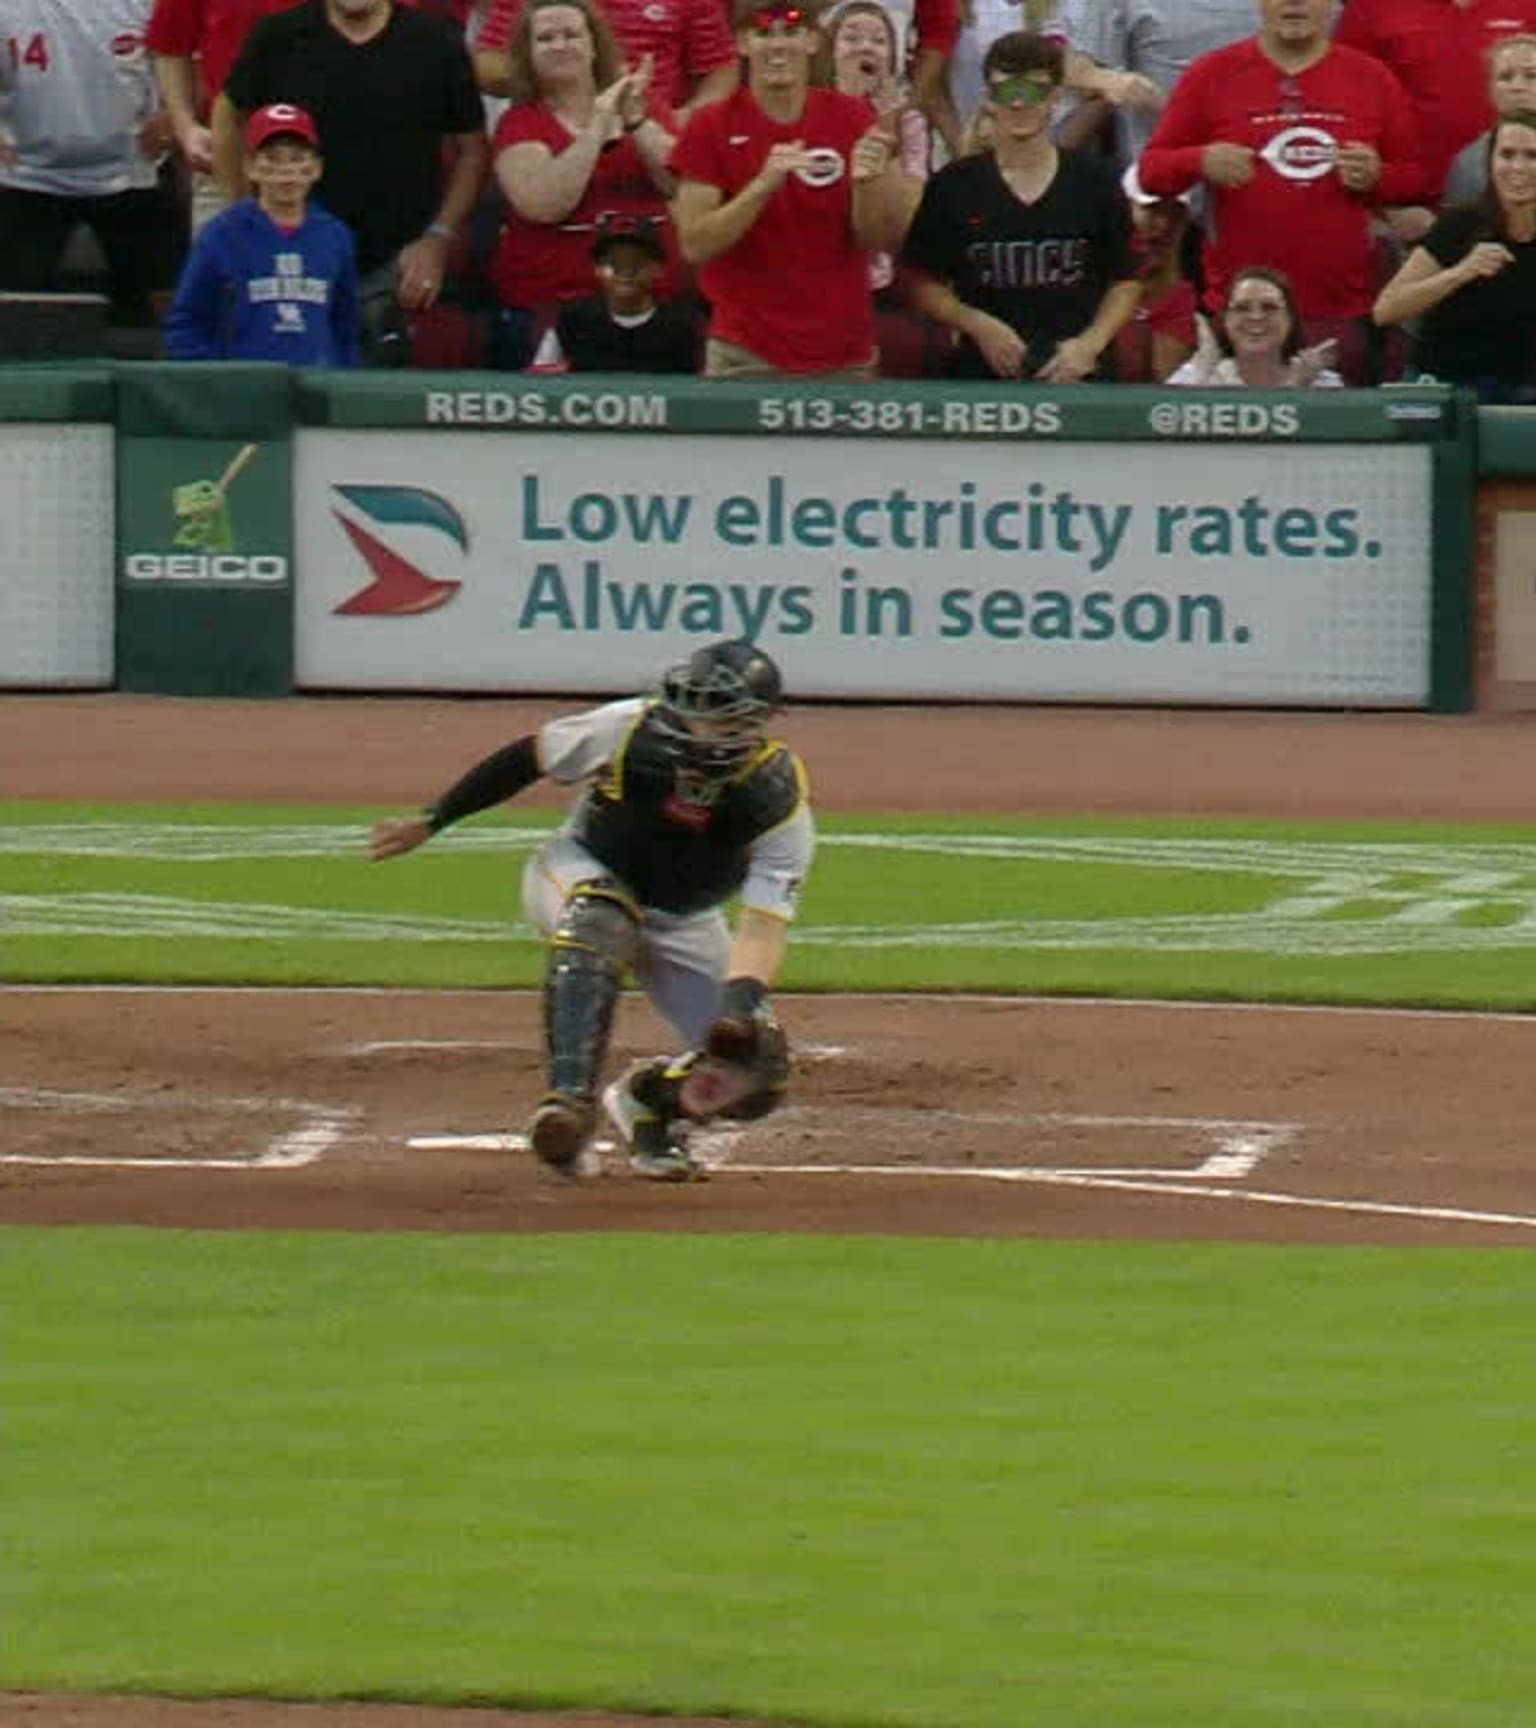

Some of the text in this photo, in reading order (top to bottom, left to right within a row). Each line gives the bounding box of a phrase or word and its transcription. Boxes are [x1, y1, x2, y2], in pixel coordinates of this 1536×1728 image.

[6, 33, 49, 72] 14
[426, 393, 668, 426] REDS.COM
[758, 398, 1062, 434] 513-381-REDS
[1149, 403, 1300, 435] @REDS
[521, 475, 1383, 572] Low electricity rates.
[126, 554, 288, 580] GEICO
[517, 561, 1252, 645] Always in season.
